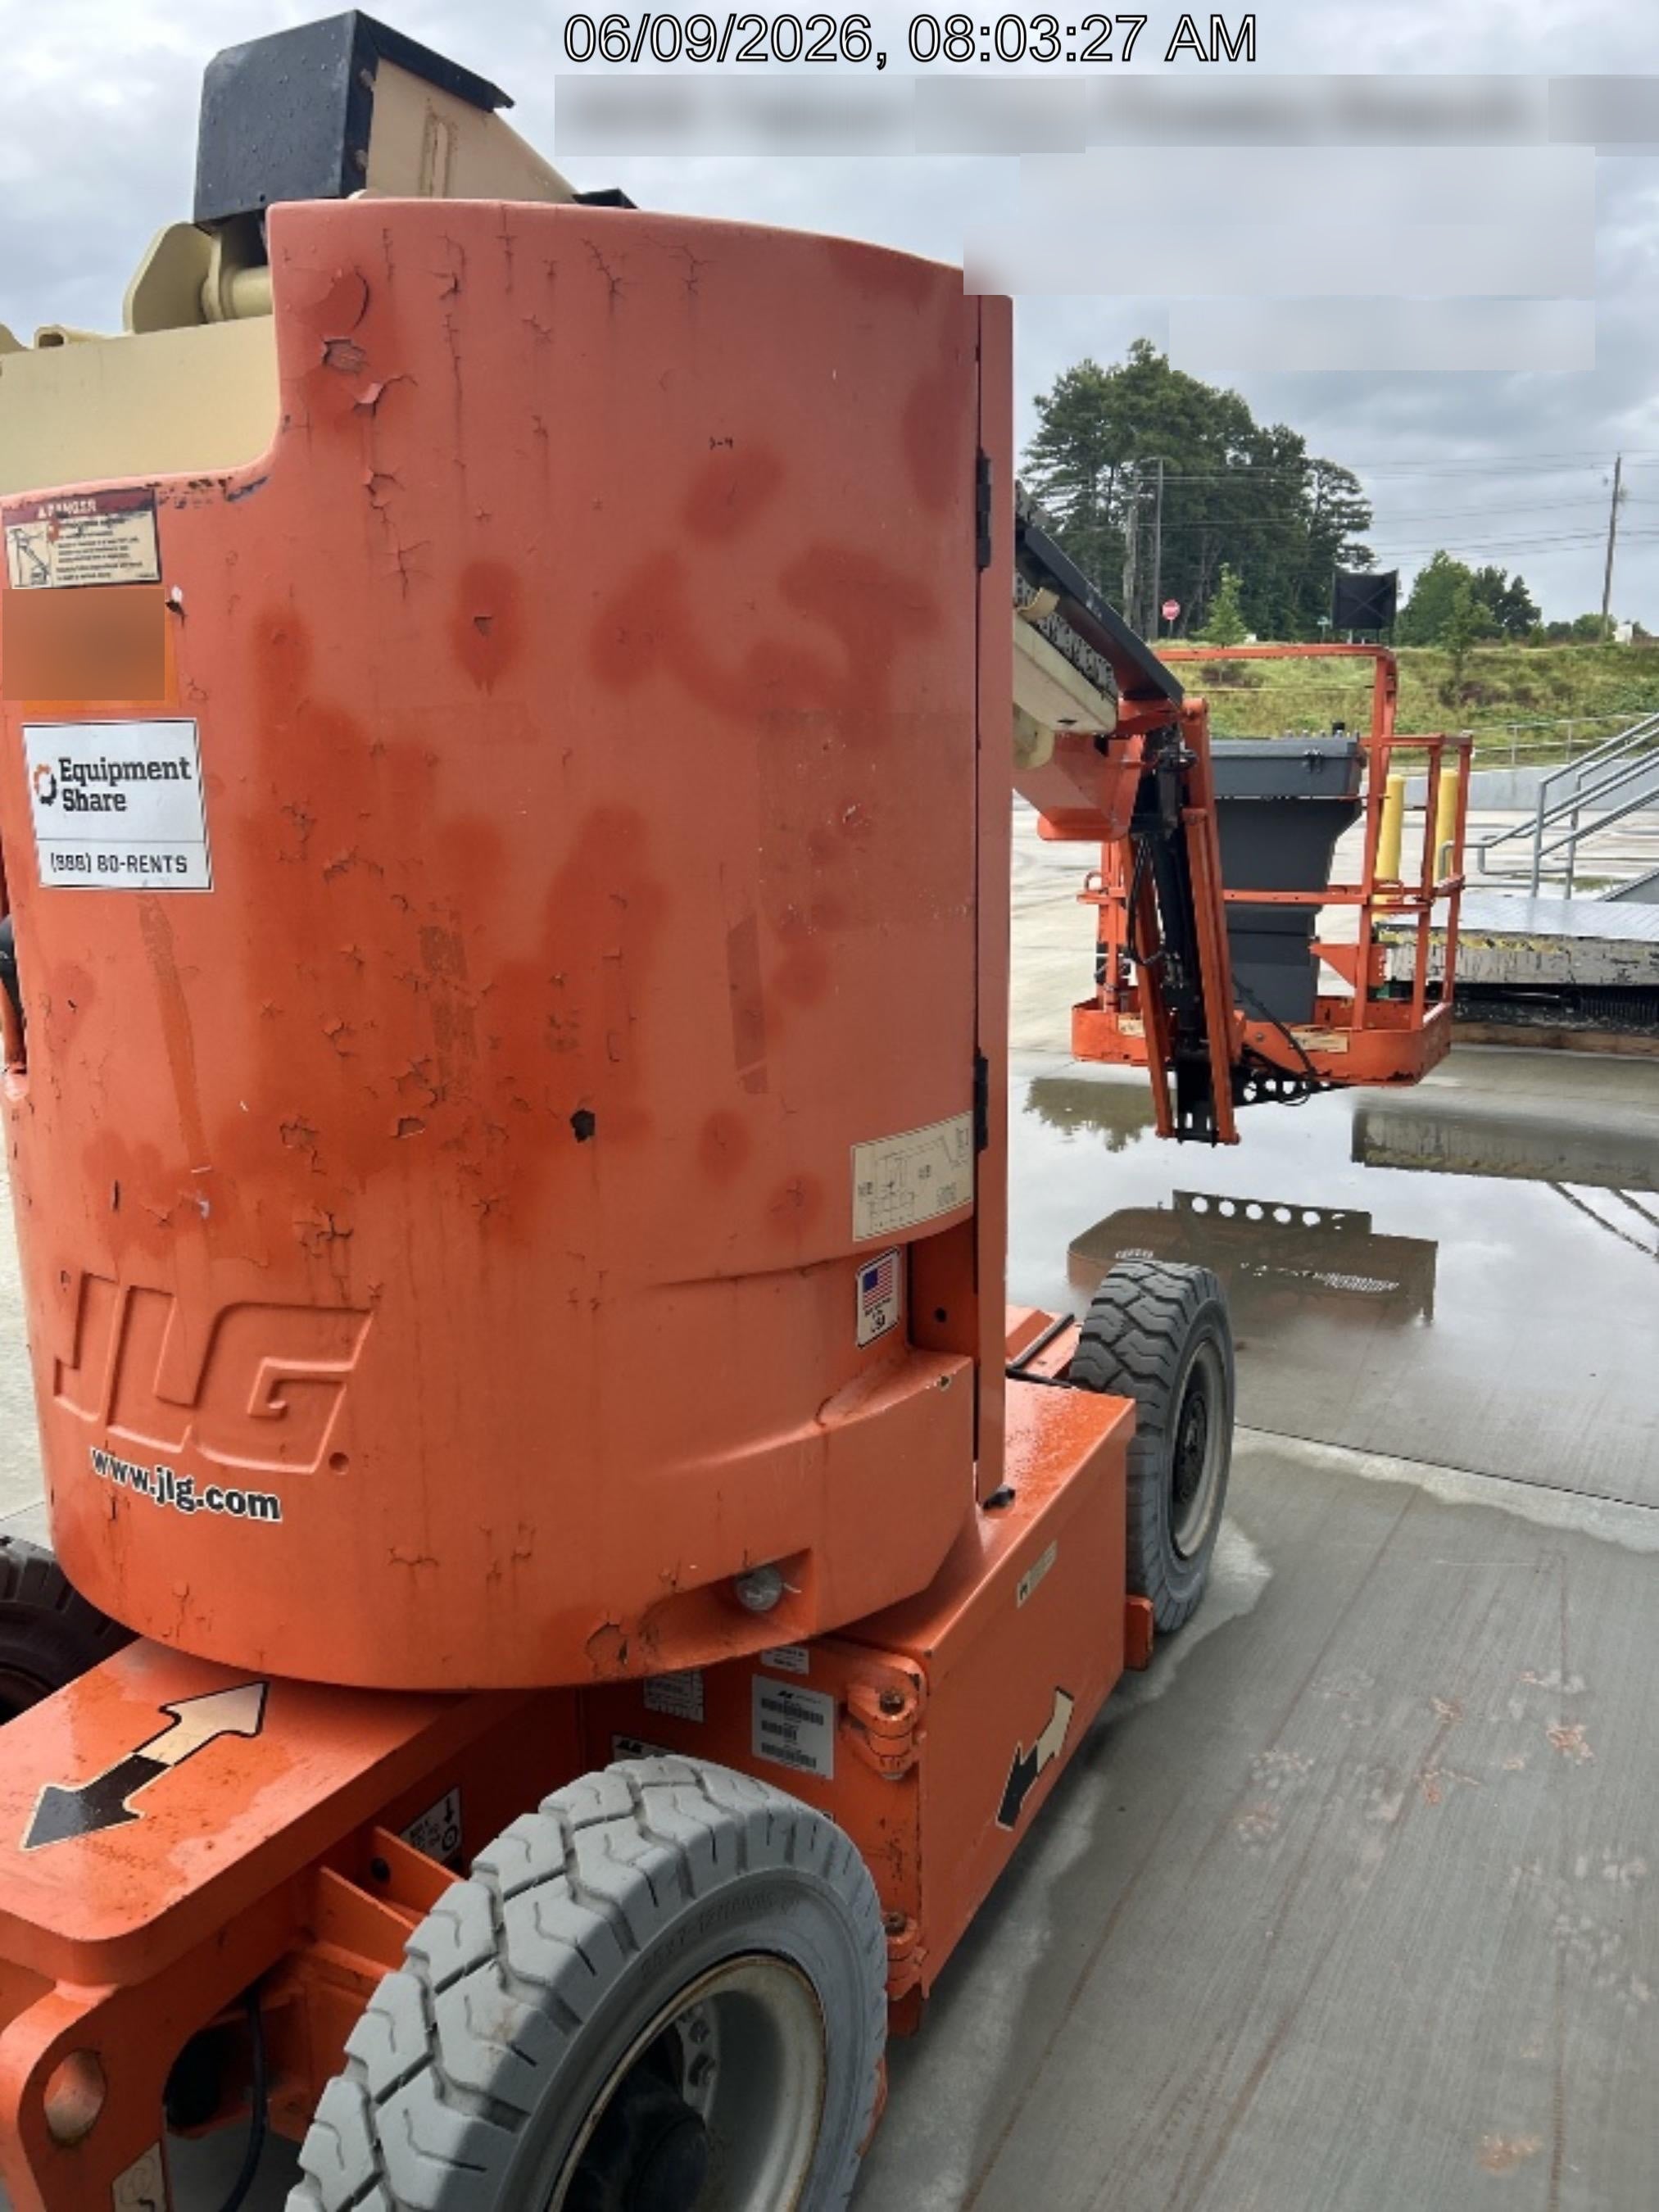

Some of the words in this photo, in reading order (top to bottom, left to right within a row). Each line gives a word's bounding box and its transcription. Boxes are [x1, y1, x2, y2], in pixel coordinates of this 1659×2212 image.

[58, 756, 192, 786] Equipment
[62, 788, 127, 812] Share
[97, 854, 188, 873] 80-RENTS
[53, 1270, 374, 1473] JLG
[90, 1447, 283, 1521] www.jlg.com
